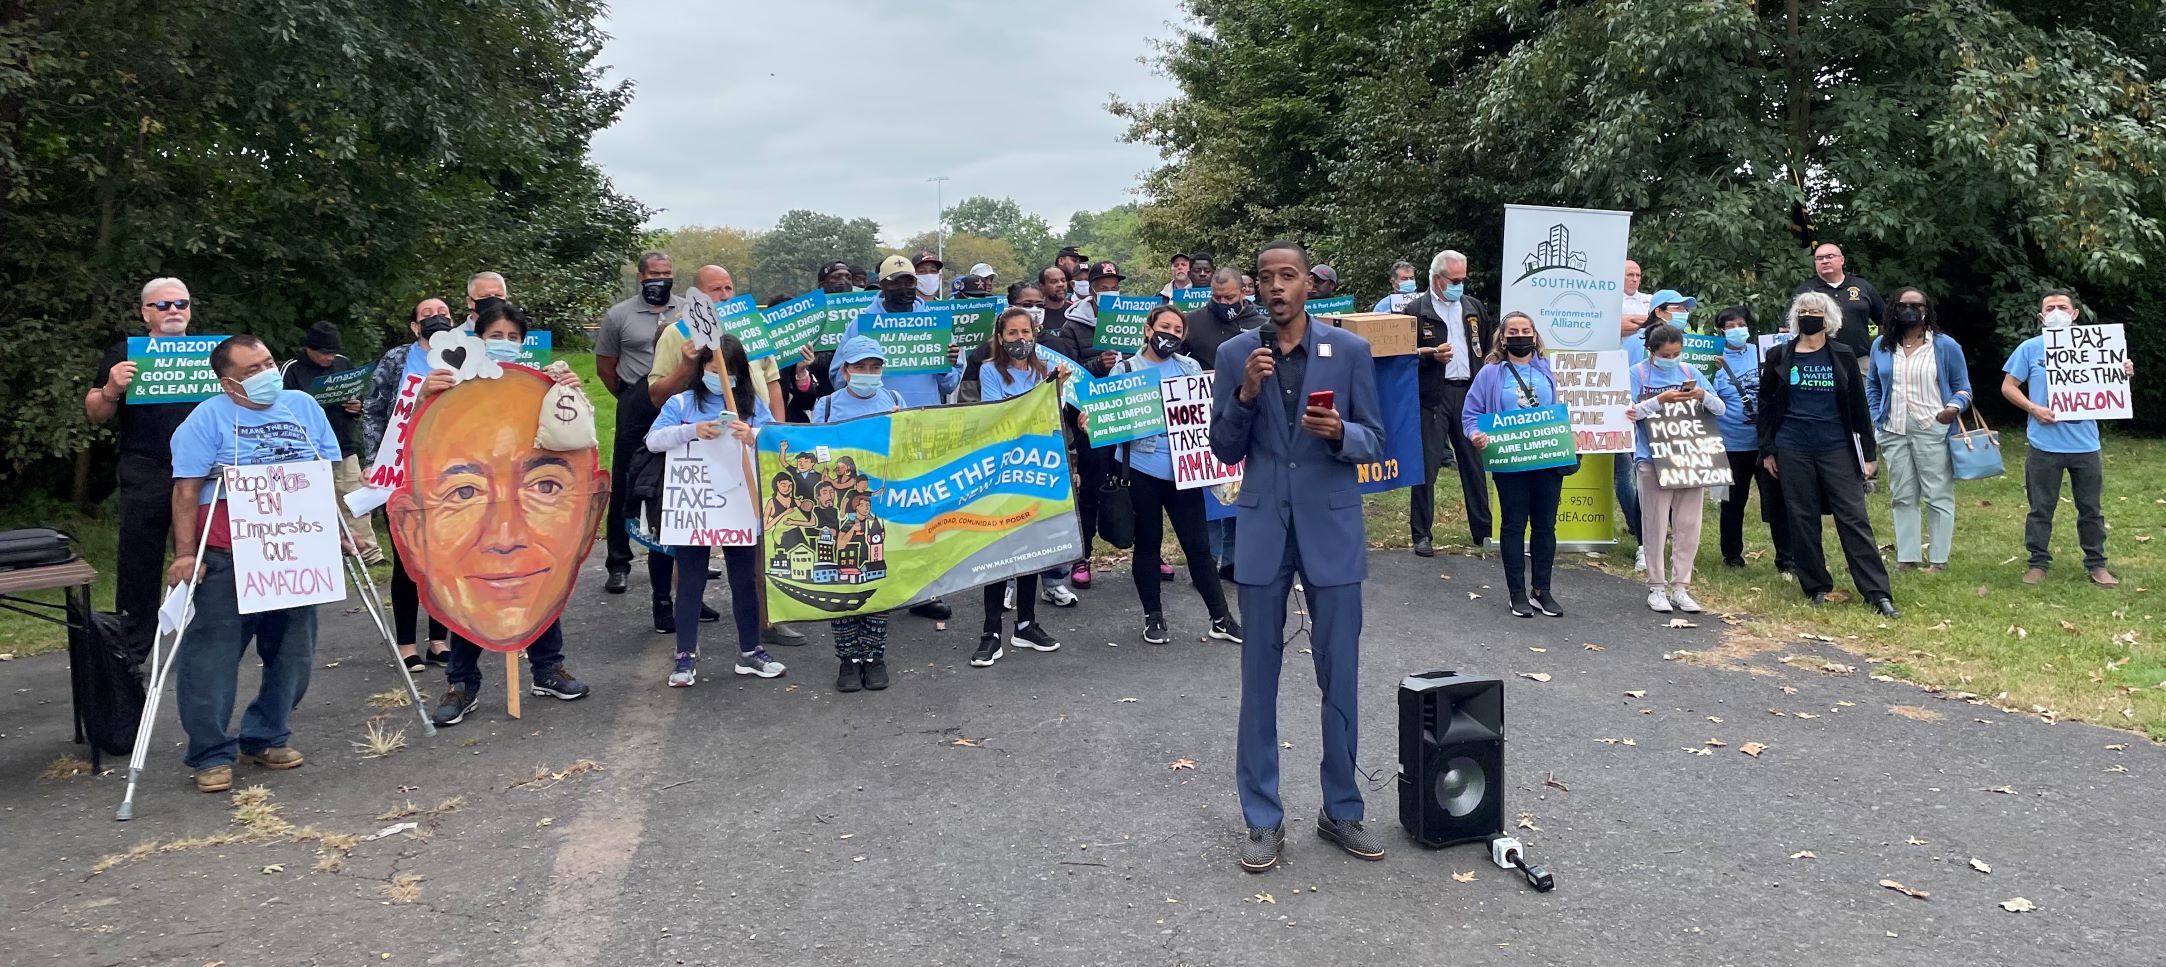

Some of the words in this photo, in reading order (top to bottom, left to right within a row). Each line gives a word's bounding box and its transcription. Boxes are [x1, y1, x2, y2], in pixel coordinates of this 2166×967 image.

[1531, 277, 1616, 291] SOUTHWARD
[842, 296, 854, 304] Port
[855, 294, 876, 302] Author
[1183, 289, 1212, 300] Amaz
[717, 300, 748, 318] azon:
[1540, 308, 1602, 318] Environmental
[724, 316, 751, 332] Needs
[768, 322, 796, 339] BAJO
[797, 310, 827, 328] DIGNO,
[872, 314, 937, 328] Amazon:
[952, 314, 980, 325] TOP
[1116, 314, 1130, 323] NJ
[1132, 315, 1147, 323] Nee
[1551, 317, 1591, 329] Alliance
[739, 326, 762, 340] JOBS
[792, 325, 820, 344] LIMPIO
[880, 333, 895, 342] NJ
[898, 332, 932, 341] Needs
[1106, 324, 1138, 334] GOOD
[751, 338, 769, 352] AIR!
[954, 332, 984, 344] RECY!
[1100, 335, 1108, 344] &
[1110, 336, 1144, 346] CLEAN
[1683, 338, 1714, 349] azon:
[2046, 328, 2064, 350] I
[2070, 326, 2112, 348] PAY
[880, 344, 906, 354] OOD
[910, 344, 942, 354] JOBS
[154, 358, 173, 368] NJ
[176, 357, 210, 367] Need
[885, 357, 918, 368] LEAN
[920, 356, 944, 366] AIR!
[1036, 344, 1086, 378] Amazon:
[1556, 352, 1598, 370] PAGO
[2046, 350, 2090, 370] MORE
[2097, 348, 2124, 364] IN
[140, 370, 186, 382] GOOD
[189, 370, 218, 380] JOB
[1585, 372, 1612, 388] EN
[1802, 372, 1834, 380] WATER
[2046, 370, 2090, 386] TAXES
[2091, 368, 2128, 384] THAN
[136, 386, 146, 395] &
[148, 384, 198, 394] CLEAN
[201, 382, 225, 393] AIR
[402, 374, 422, 398] I
[1088, 374, 1147, 396] Amazon:
[1162, 380, 1181, 402] I
[554, 395, 578, 424] $
[1083, 398, 1122, 414] TRABAJO
[1664, 399, 1698, 416] PAY
[2050, 390, 2124, 412] AMAZON
[1098, 412, 1116, 424] AIRE
[1118, 405, 1152, 420] LIMPIO
[1167, 404, 1206, 426] MORE
[1492, 410, 1554, 428] Amazon:
[1570, 410, 1604, 425] QUE
[266, 424, 282, 432] THE
[1094, 428, 1109, 438] para
[1108, 424, 1132, 434] Nueva
[1133, 414, 1164, 429] Jersey!
[1534, 426, 1568, 438] DIGNO,
[1650, 420, 1706, 438] MORE
[1170, 428, 1210, 451] TAXES
[1498, 444, 1522, 454] AIRE
[1524, 438, 1558, 450] LIMPIO
[1572, 430, 1632, 451] MAZON
[673, 438, 703, 462] I
[1510, 454, 1537, 463] Nueva
[1539, 448, 1570, 459] Jersey!
[1650, 442, 1673, 458] IN
[1670, 454, 1713, 468] THAN
[670, 465, 712, 484] MORE
[886, 480, 951, 508] MAKE
[950, 456, 996, 491] THE
[1000, 446, 1060, 470] ROAD
[1356, 459, 1399, 483] NO.73
[1660, 468, 1732, 486] AMAZON
[224, 468, 268, 502] Pago
[958, 480, 994, 505] NEW
[995, 469, 1060, 488] JERSEY
[256, 492, 282, 516] EN
[666, 486, 727, 510] TAXES
[1570, 496, 1594, 506] 9570
[662, 509, 706, 529] THAN
[958, 518, 998, 527] COMUNIDAD
[1000, 518, 1004, 526] Y
[1006, 511, 1030, 524] PODER
[232, 515, 324, 546] Impuestos
[690, 528, 752, 545] AMAZON
[262, 541, 298, 562] QUE
[972, 542, 1072, 574] WWW.MAKETHEROADNJ.ORG
[244, 567, 334, 598] AMAZON
